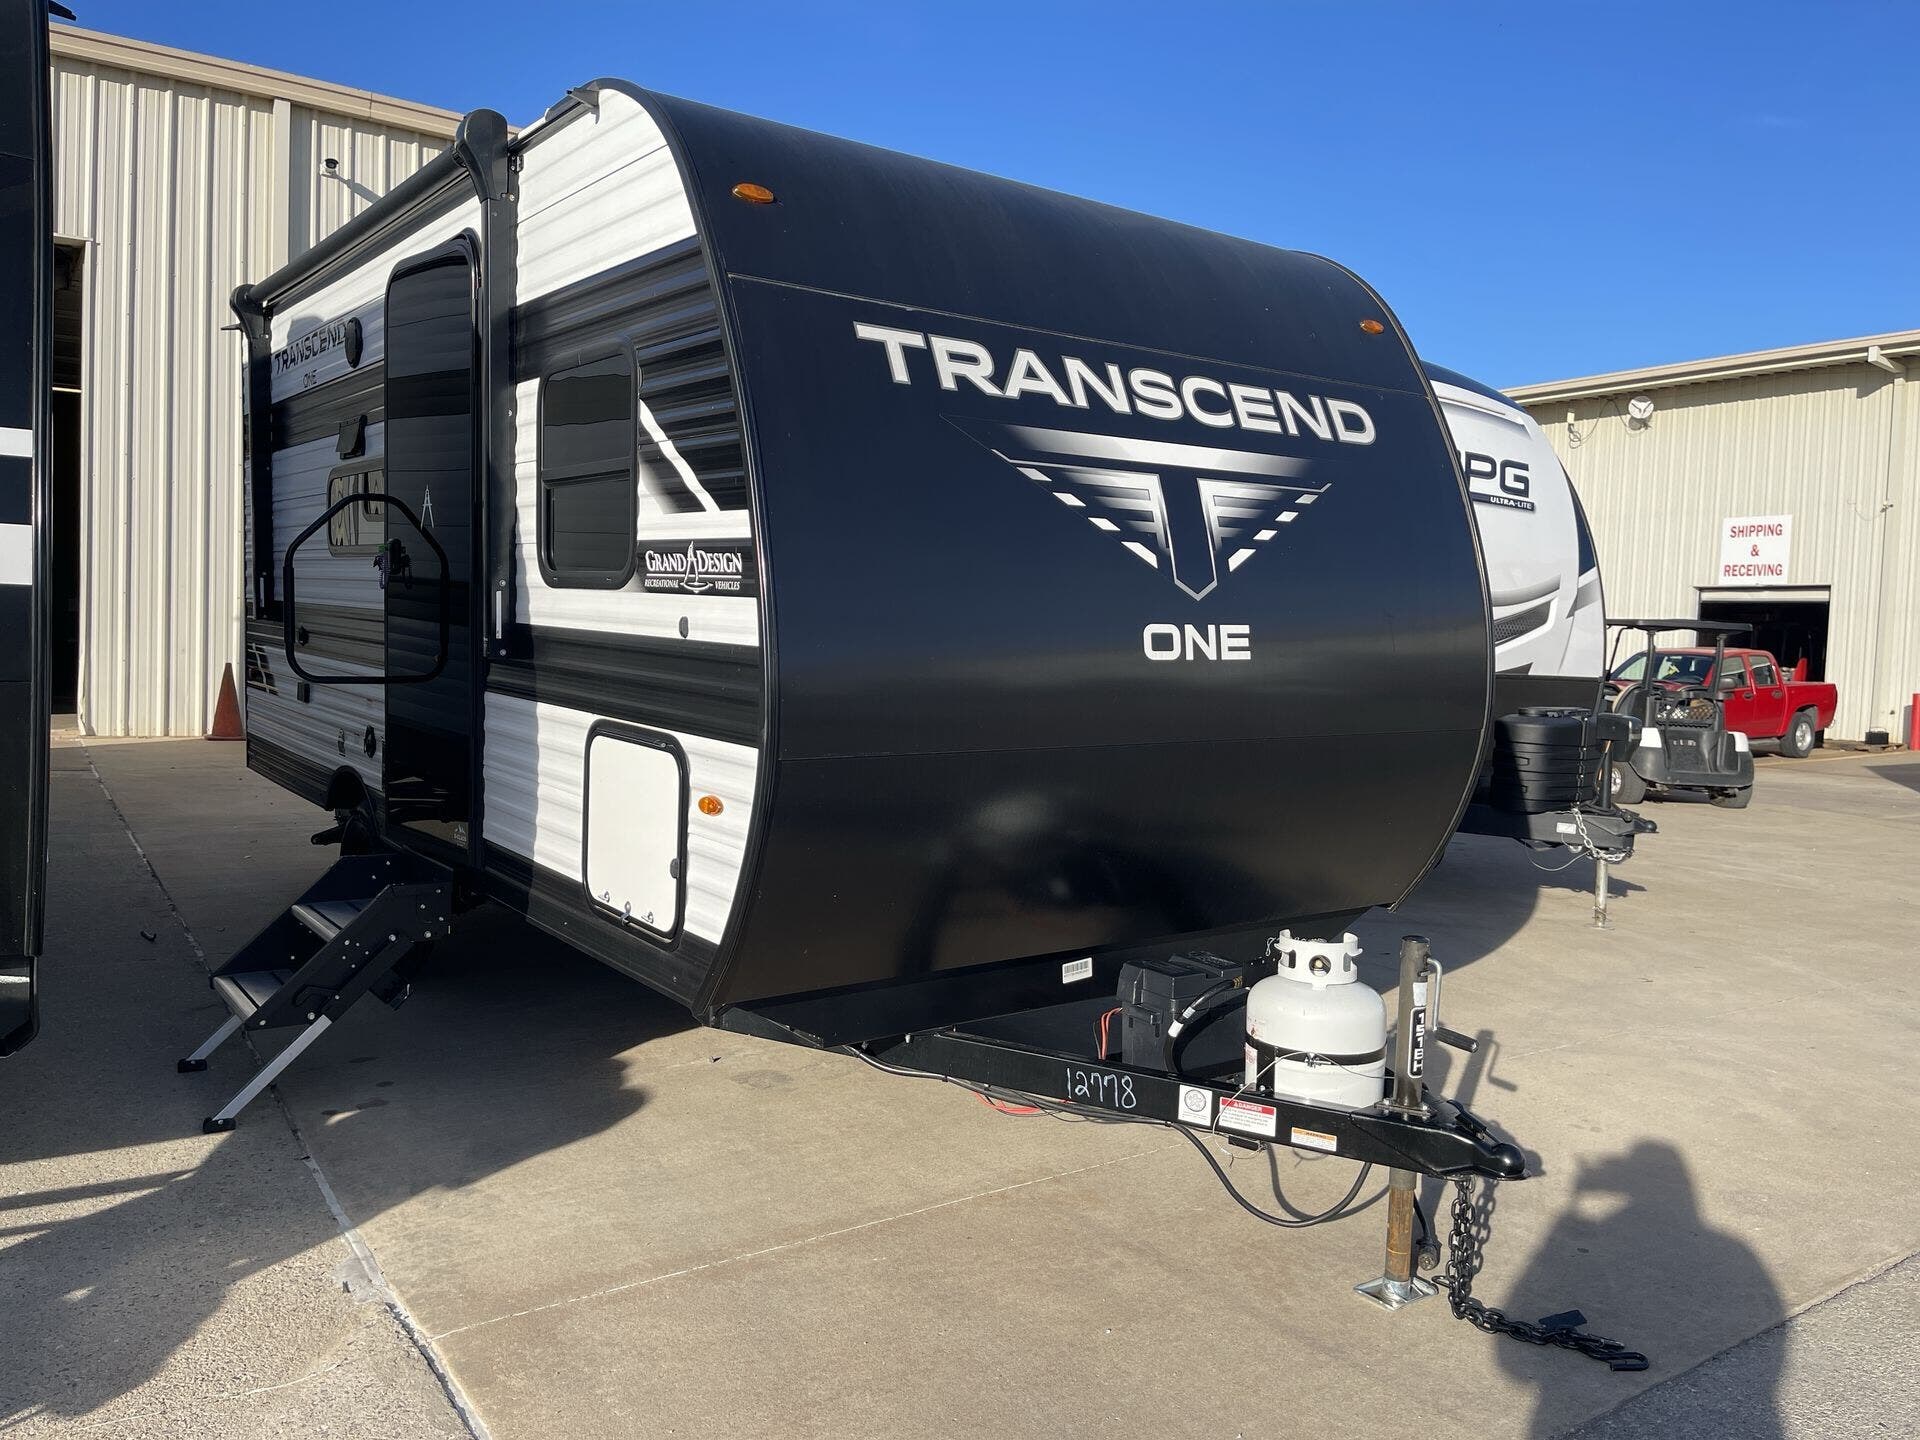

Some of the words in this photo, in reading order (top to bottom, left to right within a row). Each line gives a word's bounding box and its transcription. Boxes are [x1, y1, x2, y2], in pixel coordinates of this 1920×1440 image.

[303, 369, 317, 388] ONE
[853, 321, 1377, 446] TRANSCEND
[1458, 451, 1530, 498] PG
[1490, 496, 1532, 509] ULTRA-LITE
[1730, 523, 1783, 538] SHIPPING
[1751, 544, 1759, 557] &
[645, 550, 687, 572] GRAND
[696, 550, 743, 573] DESIGN
[1723, 563, 1783, 577] RECEIVING
[644, 579, 679, 588] RECREATIONAL
[715, 581, 740, 590] VEHICLES
[1142, 623, 1252, 662] ONE
[1066, 1067, 1137, 1109] 12778
